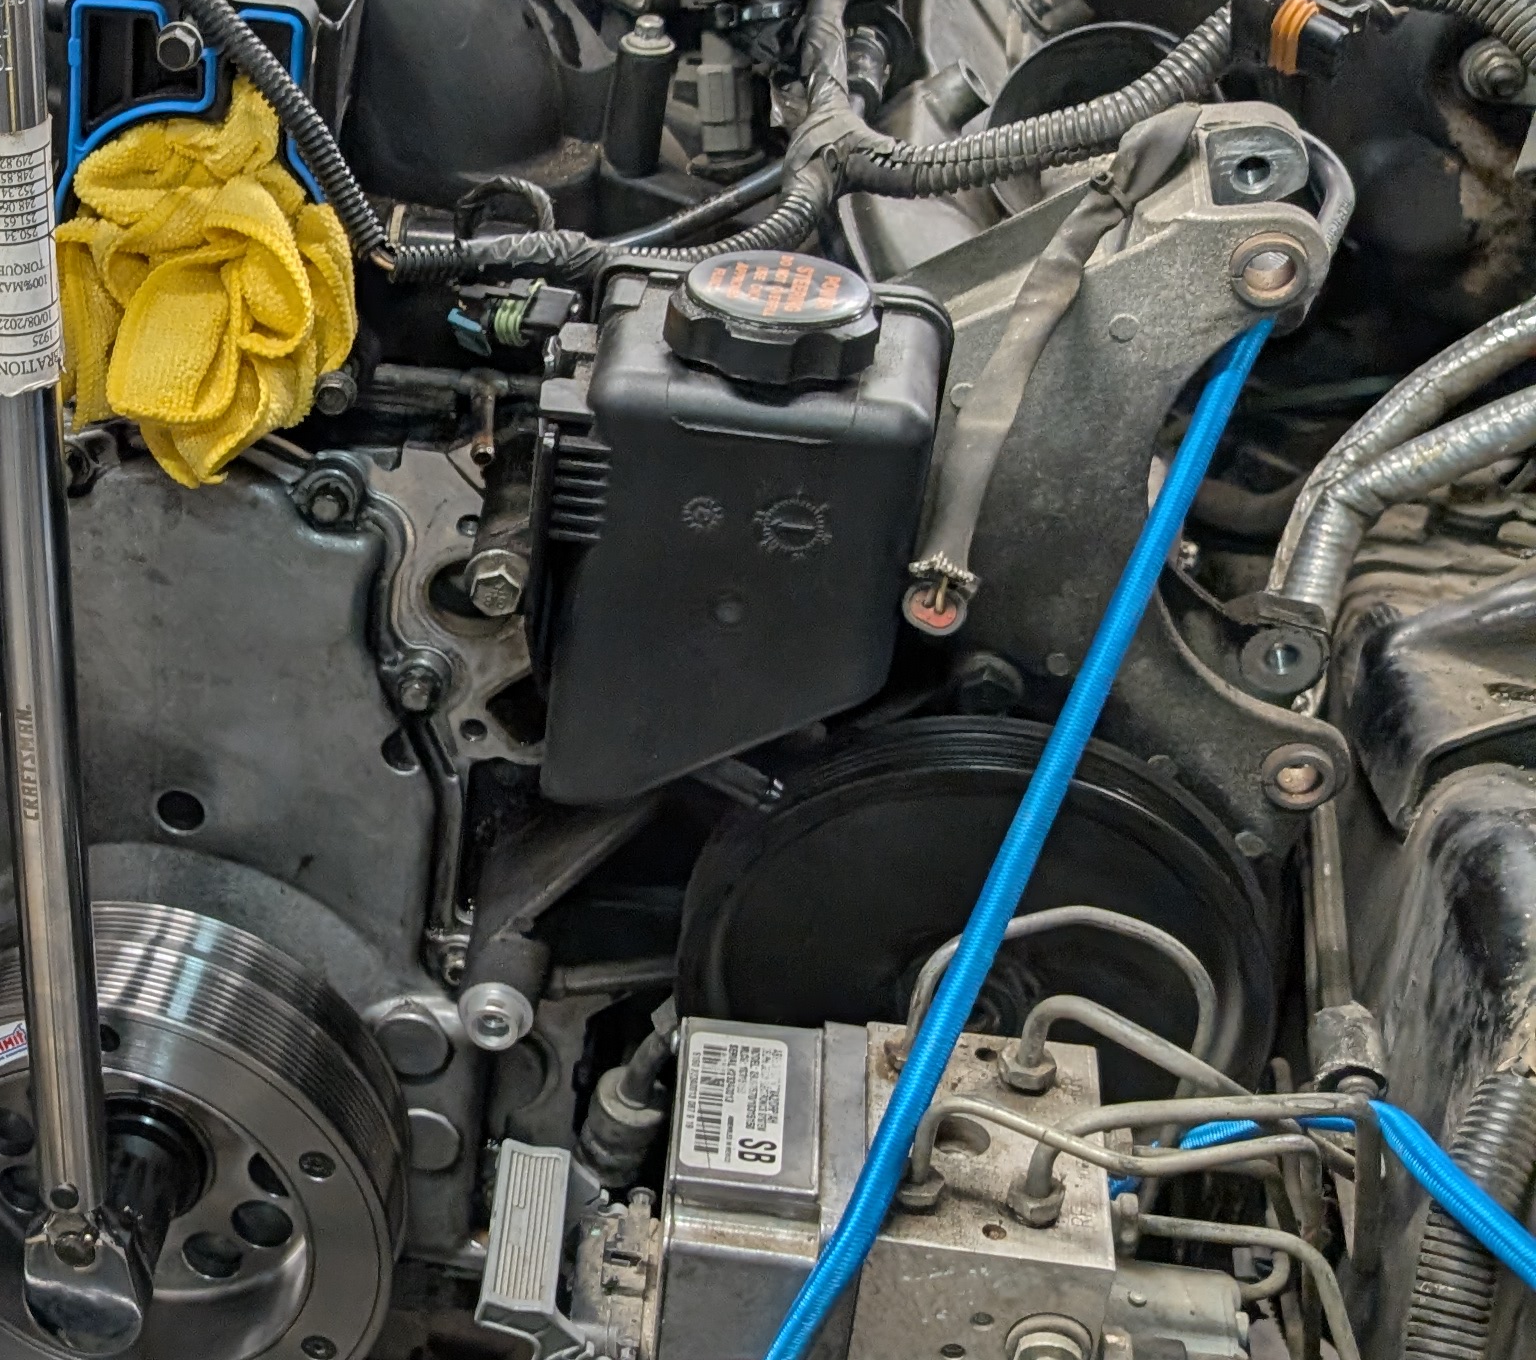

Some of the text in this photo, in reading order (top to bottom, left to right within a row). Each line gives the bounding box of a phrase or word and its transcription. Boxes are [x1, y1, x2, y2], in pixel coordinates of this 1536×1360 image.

[0, 154, 33, 169] 249.82
[0, 169, 34, 184] 248.85
[2, 183, 35, 198] 252.34
[3, 198, 36, 213] 248.06
[4, 213, 36, 228] 251.65
[5, 227, 38, 241] 250.34
[784, 266, 814, 312] STEERING
[32, 330, 53, 347] 1925
[16, 706, 41, 822] CRAFTSMAN
[738, 1138, 777, 1163] SB
